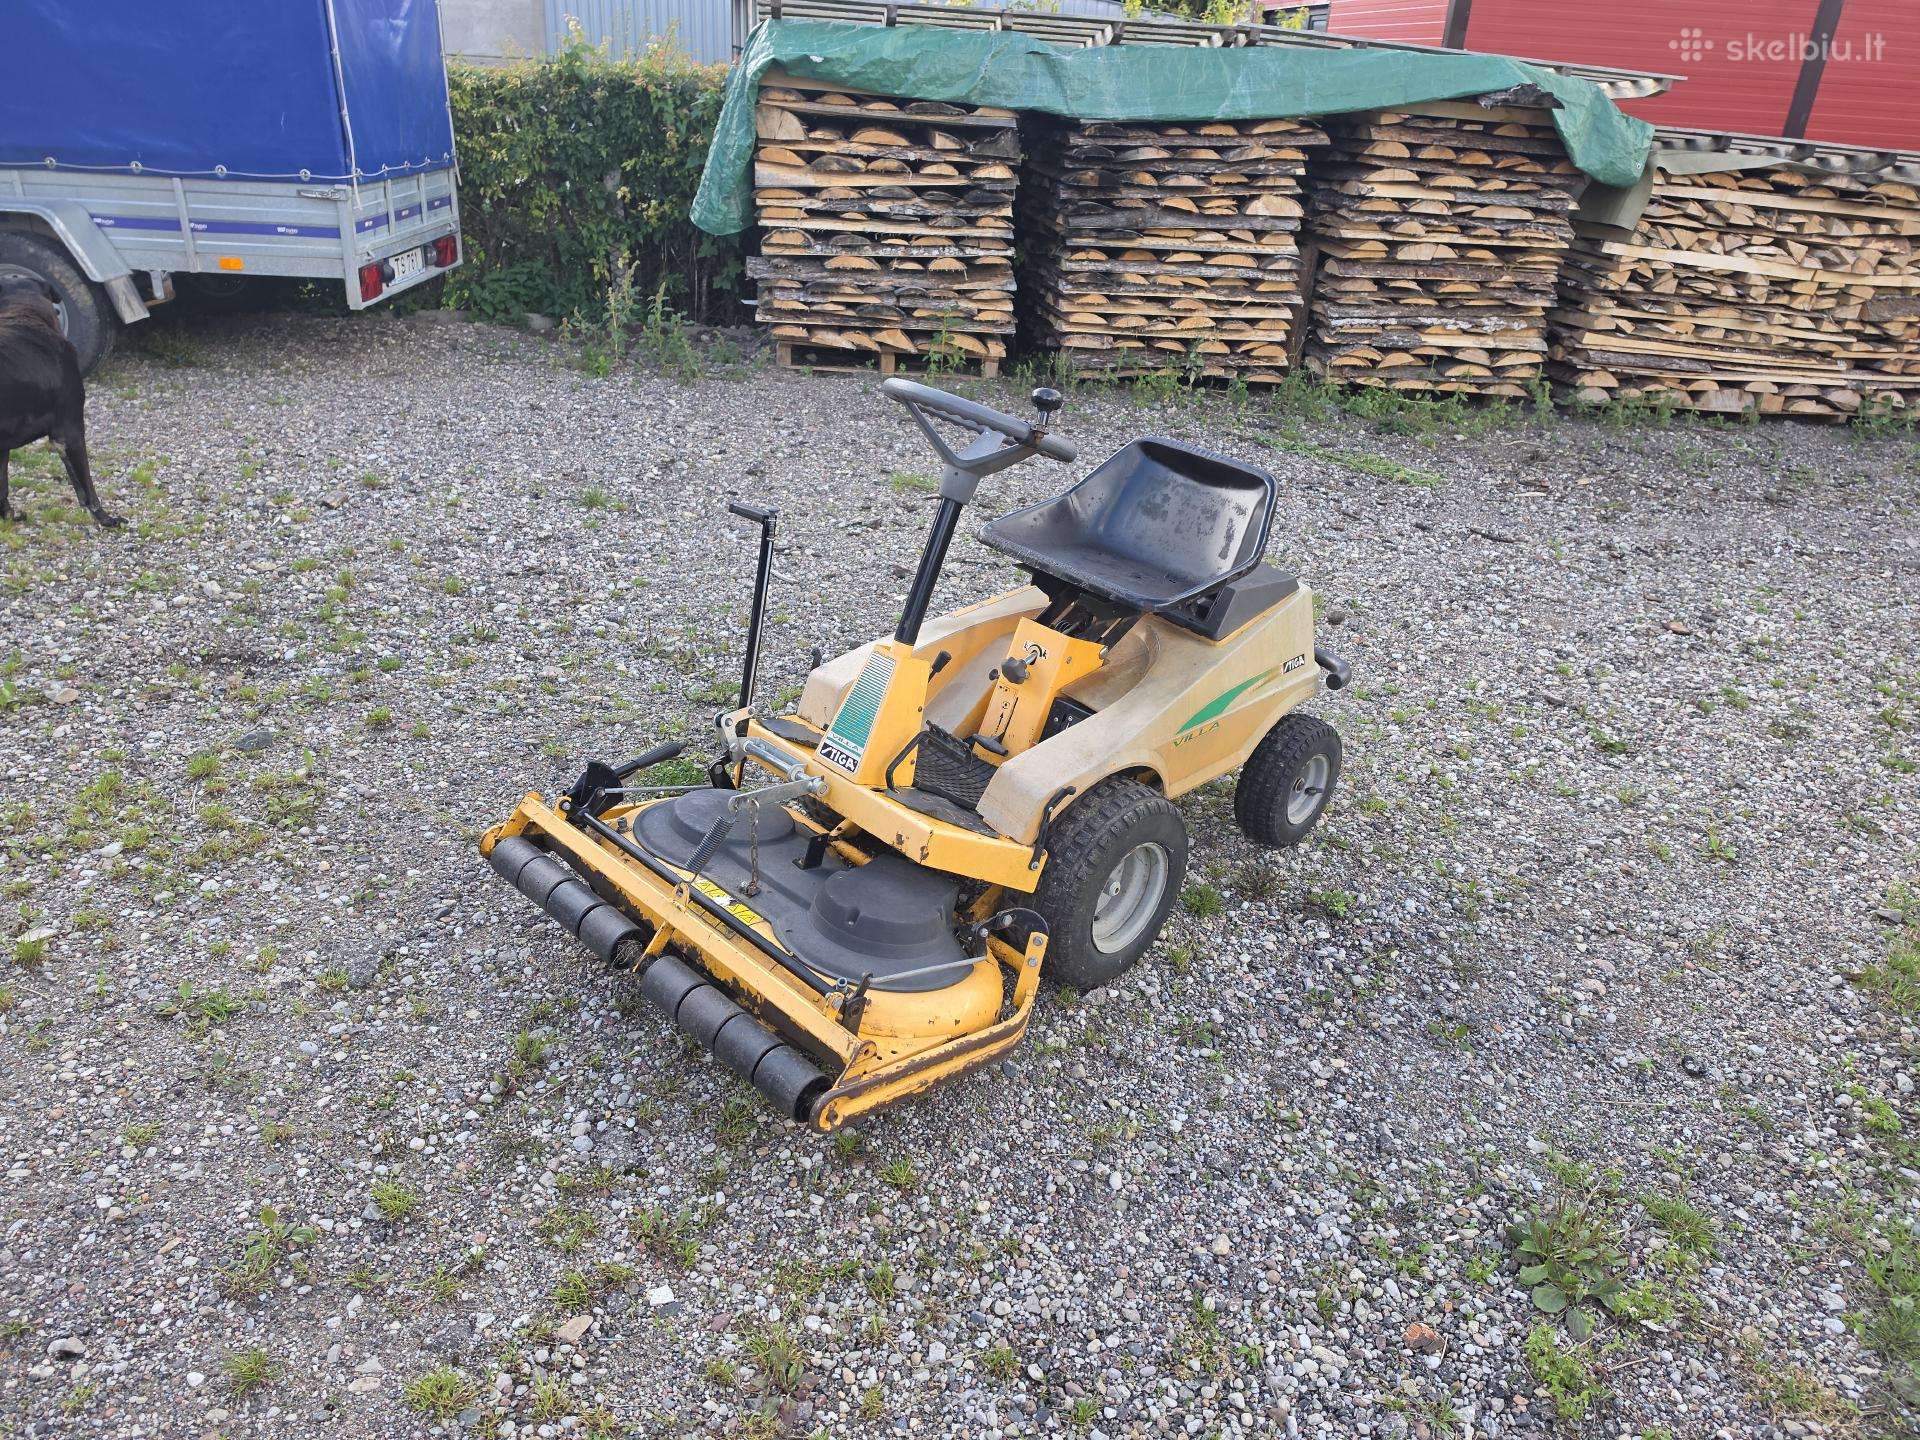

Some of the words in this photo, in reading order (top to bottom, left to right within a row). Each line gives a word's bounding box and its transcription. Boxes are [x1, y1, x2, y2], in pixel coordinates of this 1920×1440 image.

[1284, 655, 1305, 674] STIGA
[831, 733, 859, 751] VILLA
[1174, 721, 1219, 747] VILLA
[821, 747, 855, 772] STIGA
